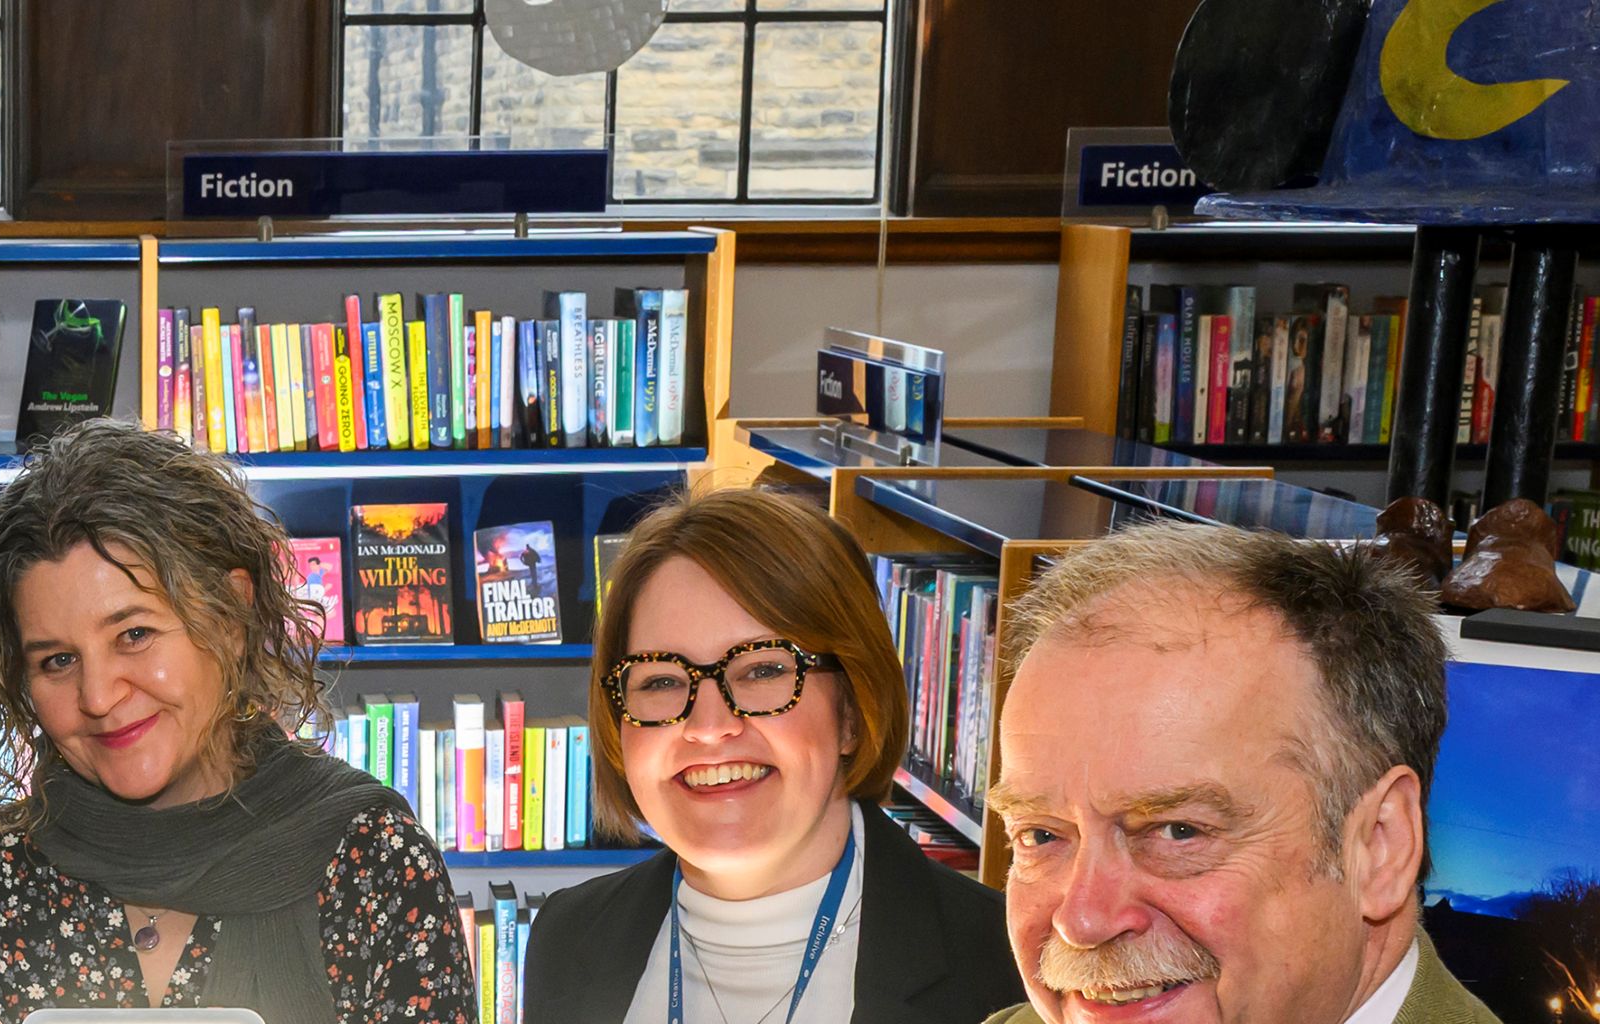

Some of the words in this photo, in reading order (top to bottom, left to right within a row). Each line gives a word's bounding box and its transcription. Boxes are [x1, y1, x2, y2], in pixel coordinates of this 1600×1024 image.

[200, 173, 293, 198] Fiction
[1101, 161, 1196, 188] Fiction
[1183, 296, 1194, 333] GLASS
[387, 301, 401, 375] MOSCOW
[574, 307, 583, 379] BREATHLESS
[595, 332, 606, 362] GIRL
[645, 325, 658, 378] McDermid
[668, 325, 680, 377] McDermid
[1181, 337, 1193, 384] HOUSES
[338, 365, 350, 406] GOING
[391, 379, 402, 390] X
[418, 371, 426, 387] THE
[820, 368, 843, 400] Fiction
[27, 401, 63, 412] Andrew
[63, 402, 99, 413] Lipstein
[420, 390, 428, 431] SEVENTH
[644, 380, 656, 412] 1979
[667, 380, 679, 412] 1989
[341, 408, 352, 439] ZERO
[357, 545, 379, 556] IAN
[380, 544, 446, 556] McDONALD
[384, 556, 418, 570] THE
[358, 567, 447, 589] WILDING
[482, 579, 531, 604] FINAL
[484, 596, 556, 623] TRAITOR
[487, 622, 508, 637] ANDY
[508, 617, 557, 636] McDERMOTT
[510, 713, 520, 728] THE
[509, 731, 520, 762] ISLAND
[508, 920, 516, 943] Clare
[501, 962, 513, 1024] HOSTAGE
